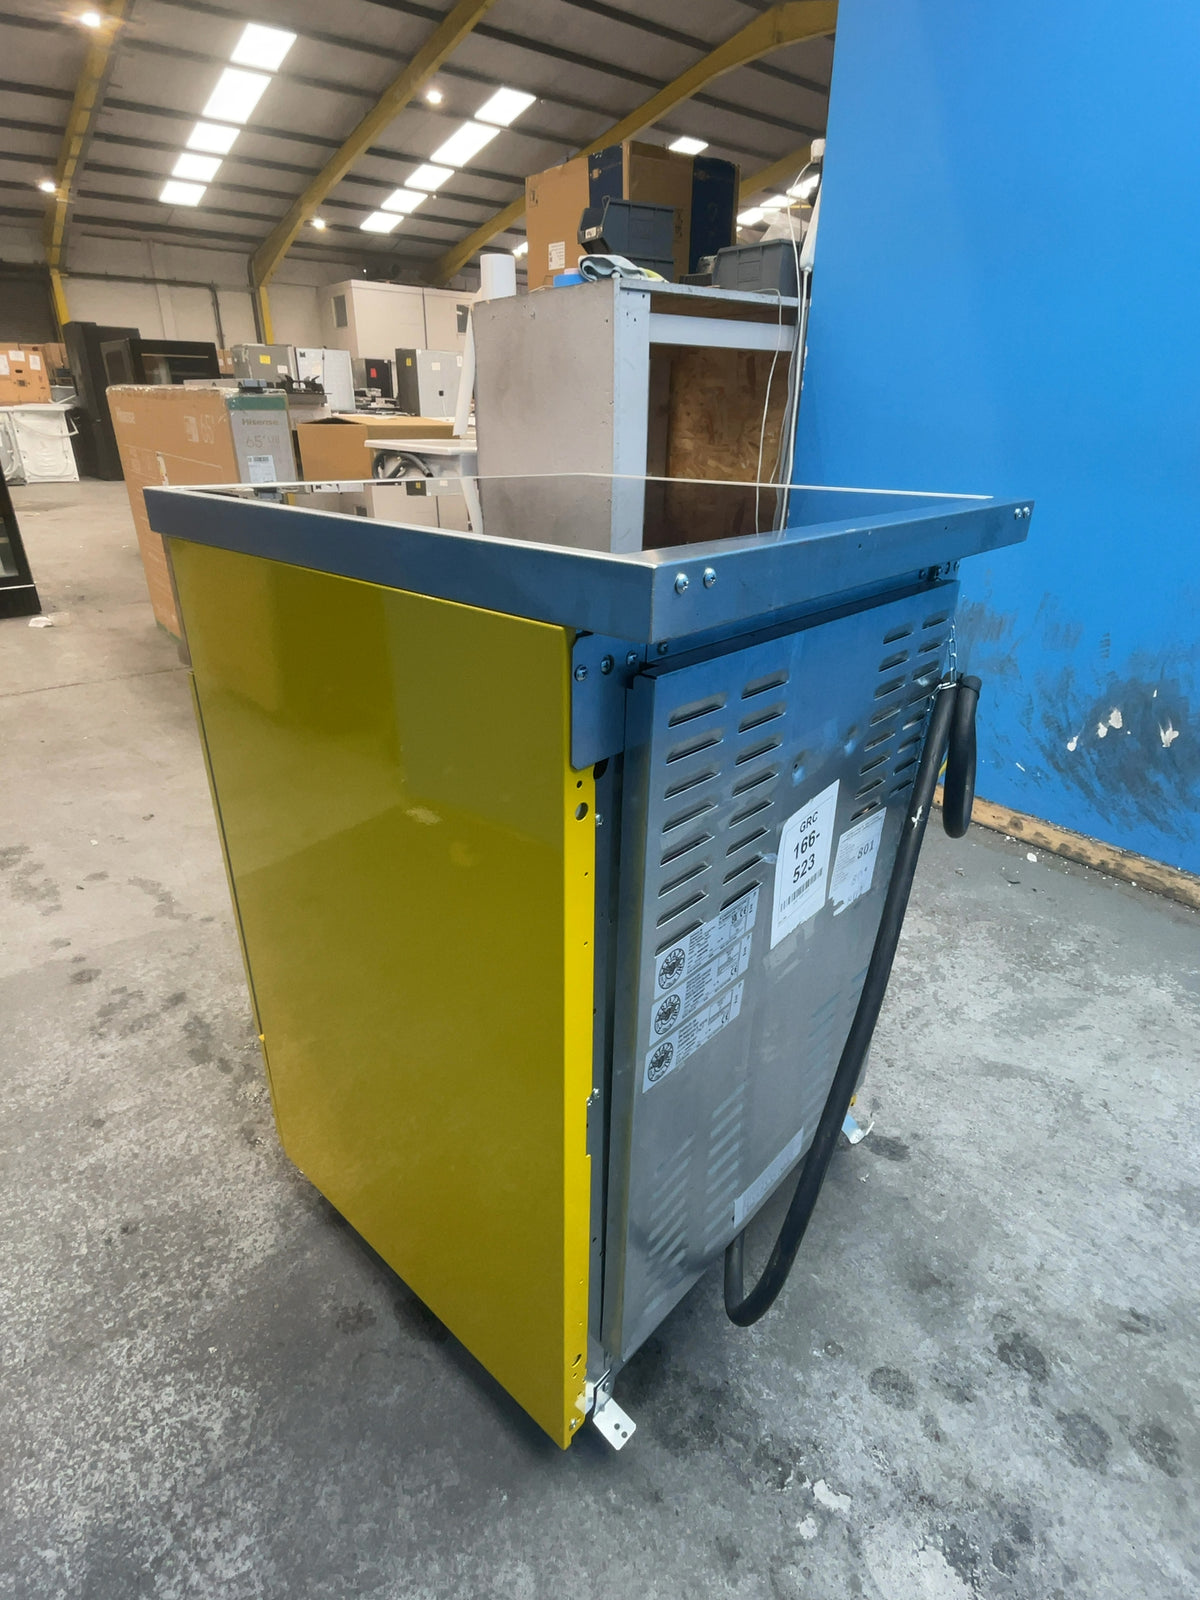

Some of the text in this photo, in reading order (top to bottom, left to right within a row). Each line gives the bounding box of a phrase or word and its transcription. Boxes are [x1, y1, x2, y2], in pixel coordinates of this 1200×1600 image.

[242, 418, 280, 426] Hisense
[800, 811, 818, 833] GRC
[793, 830, 820, 859] 166-
[792, 853, 815, 884] 523
